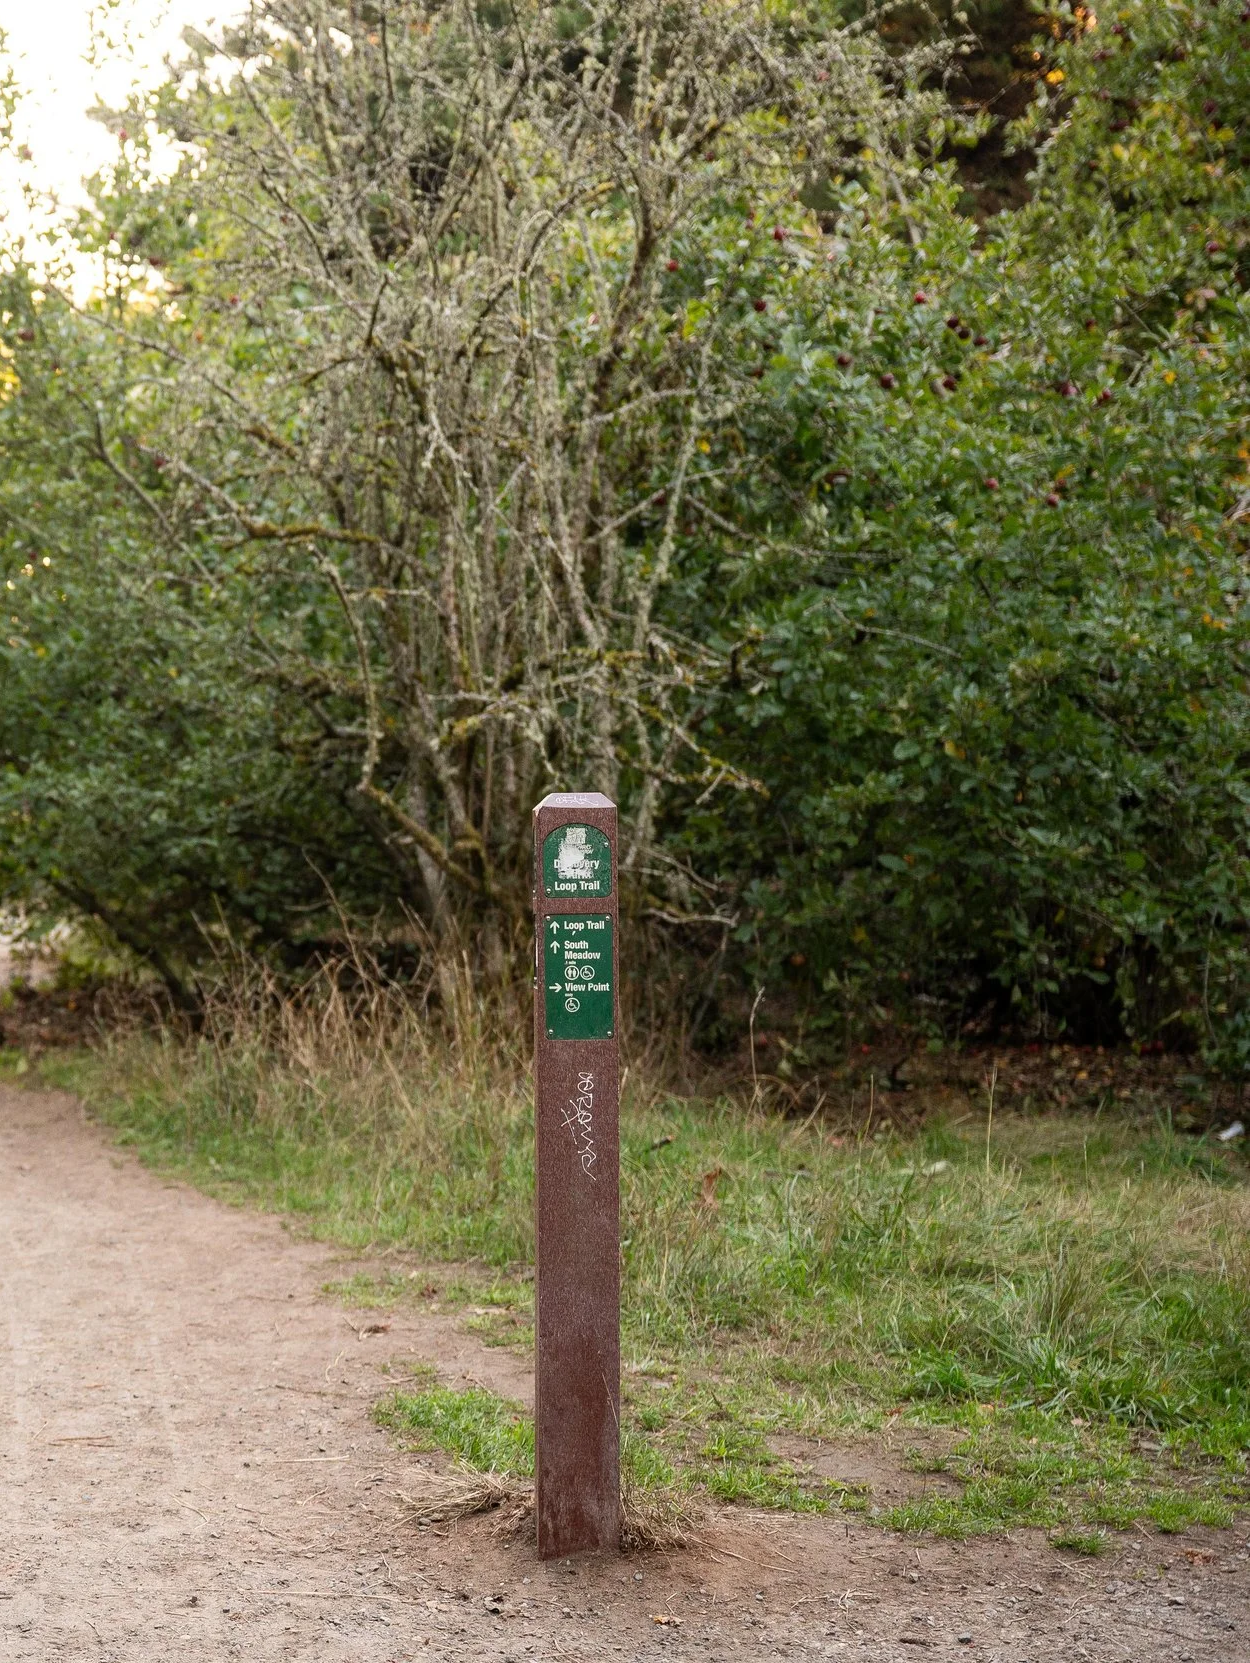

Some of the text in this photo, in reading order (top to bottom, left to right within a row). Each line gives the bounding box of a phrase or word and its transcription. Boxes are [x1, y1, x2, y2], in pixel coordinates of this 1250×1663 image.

[554, 881, 600, 892] Loop Trail
[564, 920, 604, 931] Loop Trail
[564, 940, 588, 949] South
[564, 951, 600, 959] Meadow
[565, 982, 610, 991] View Point
